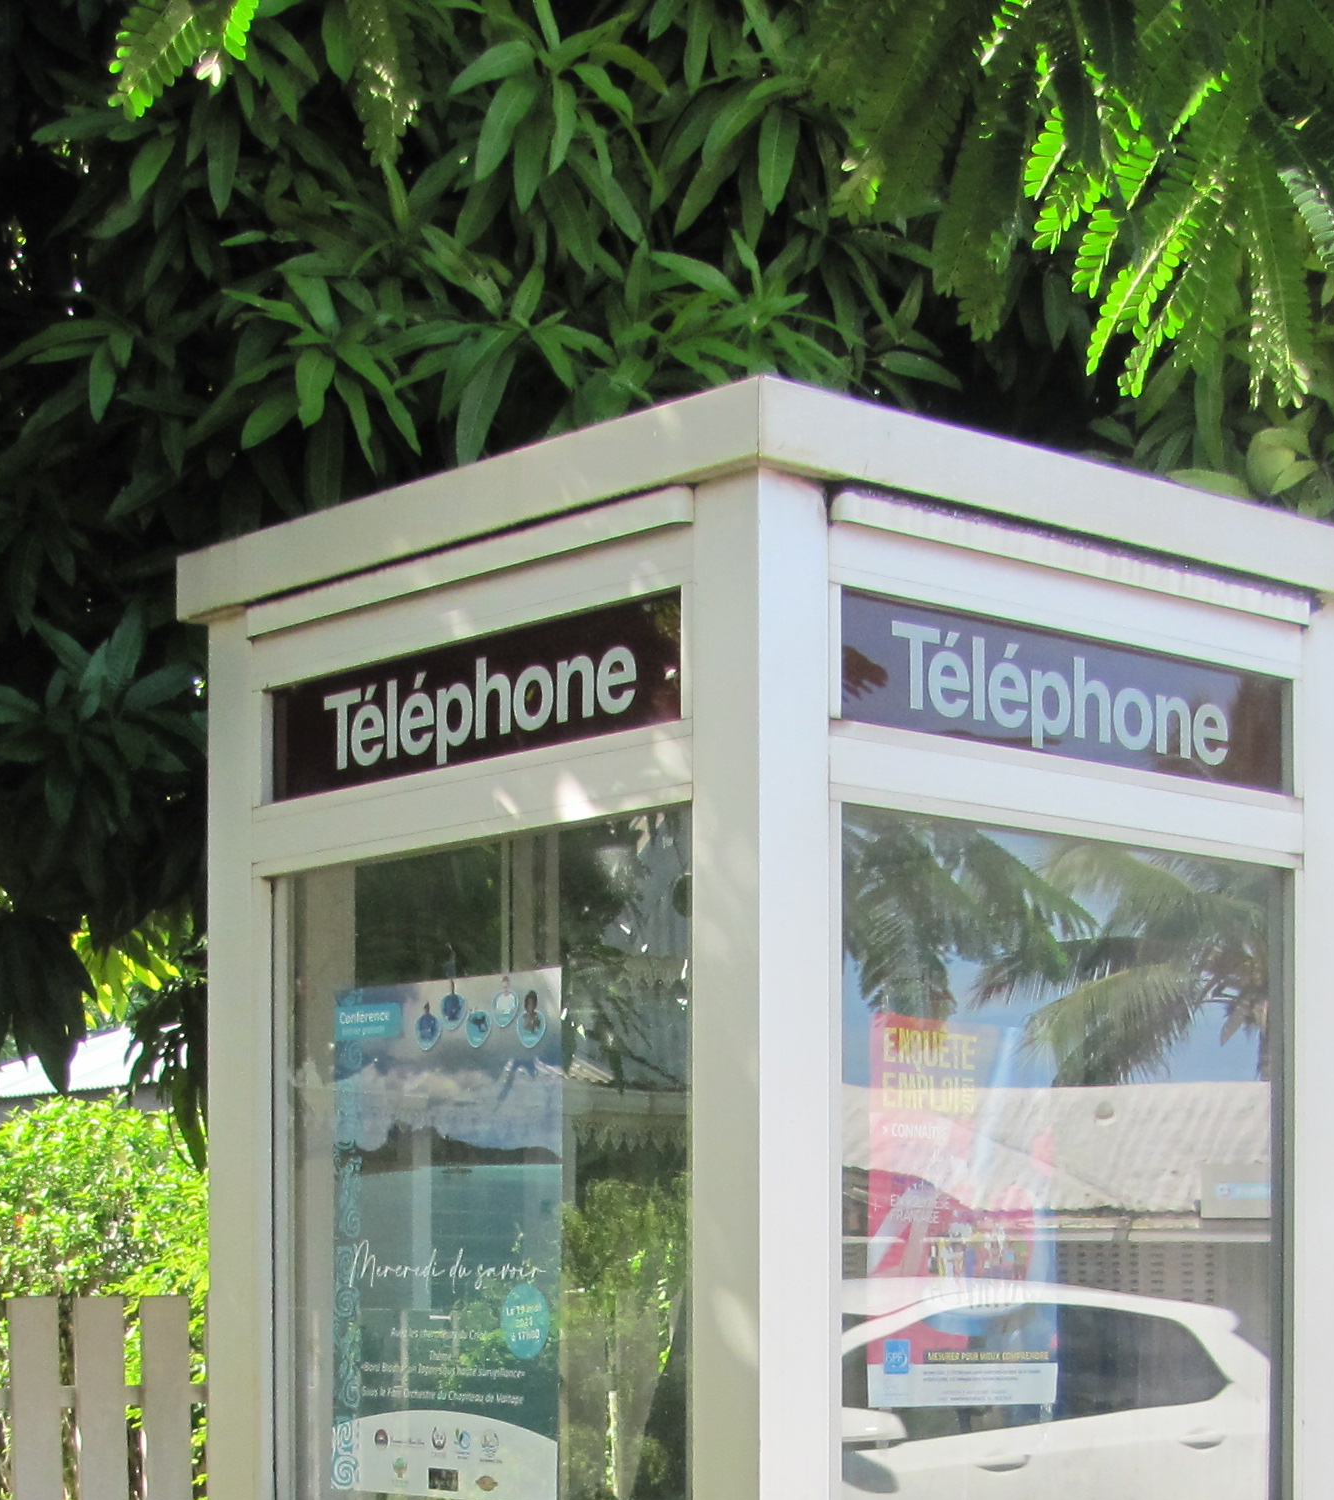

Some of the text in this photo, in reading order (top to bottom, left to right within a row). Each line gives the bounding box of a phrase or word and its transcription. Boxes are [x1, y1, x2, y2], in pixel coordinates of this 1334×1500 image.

[323, 645, 637, 770] Téléphone
[891, 620, 1229, 766] Téléphone
[882, 1024, 977, 1072] ENQUÊTE
[882, 1072, 959, 1114] EMPLOI
[348, 1239, 445, 1294] Mercredi
[449, 1247, 473, 1294] du
